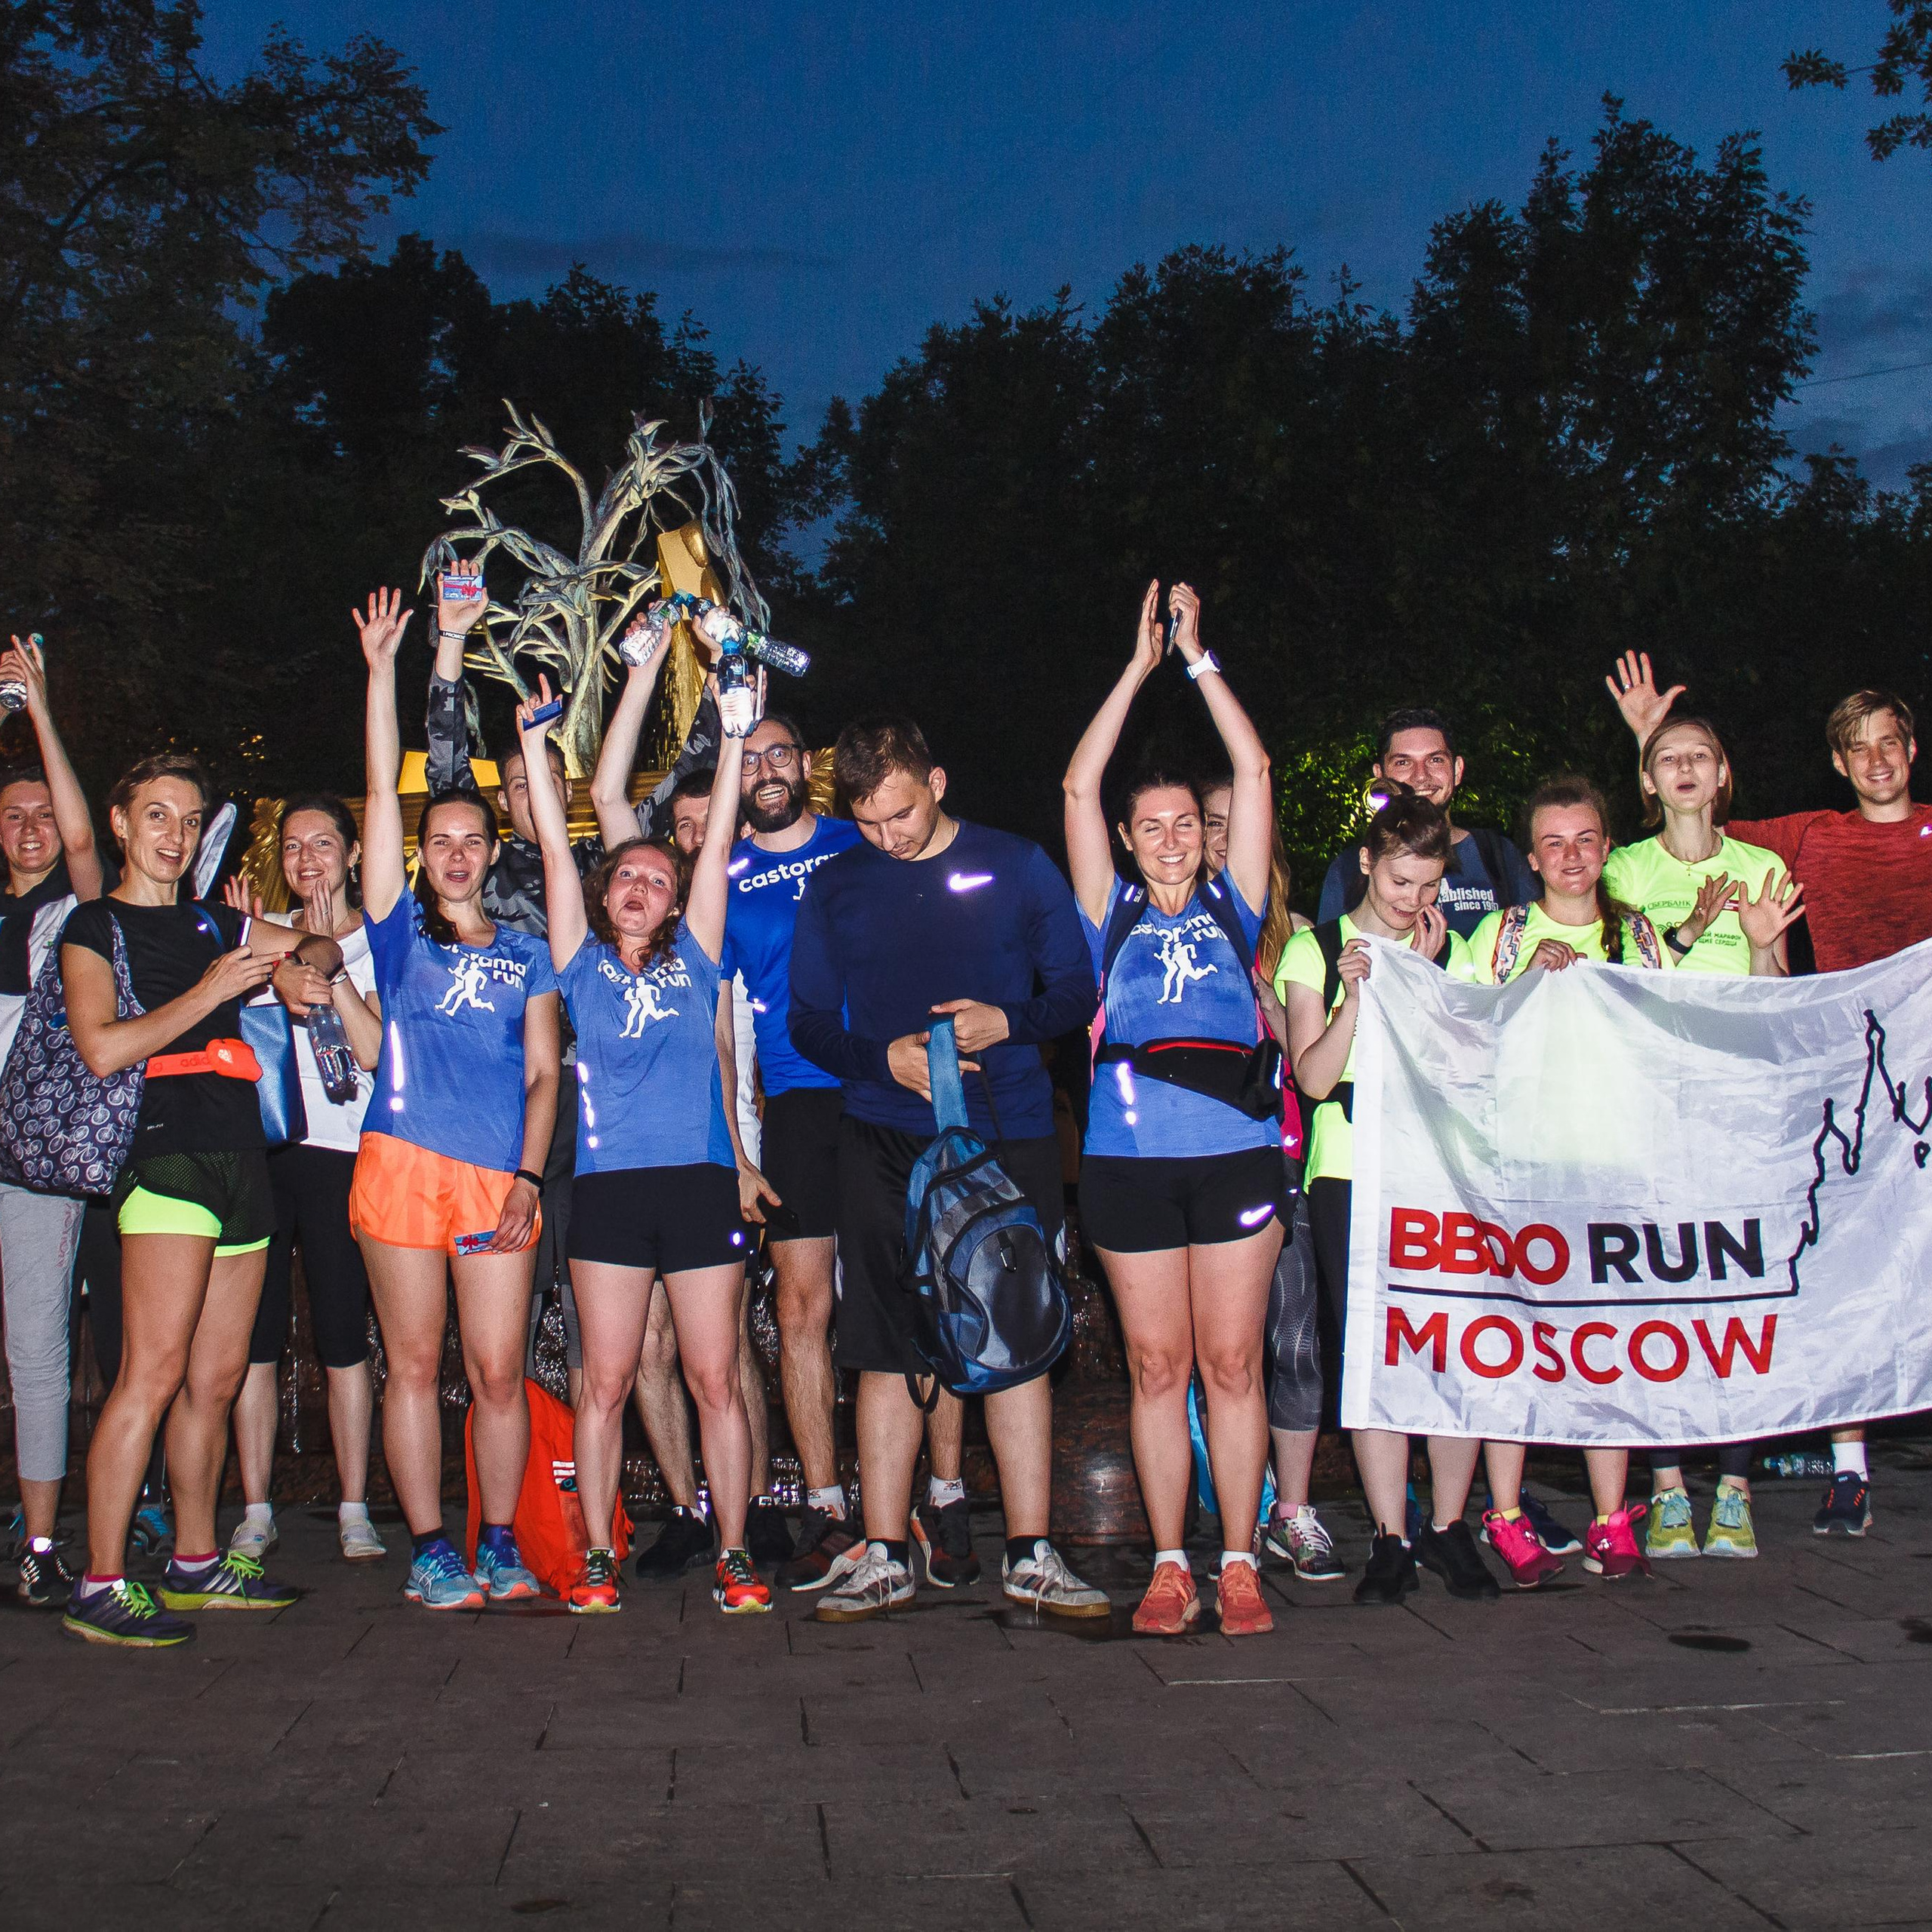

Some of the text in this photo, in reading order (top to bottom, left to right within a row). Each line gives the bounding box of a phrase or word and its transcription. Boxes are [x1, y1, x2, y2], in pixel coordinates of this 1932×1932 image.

[739, 853, 838, 893] castor
[1454, 900, 1481, 912] since
[1648, 900, 1692, 910] СБЕРБАНК
[1192, 925, 1229, 942] run
[493, 969, 524, 992] run
[657, 973, 692, 989] run
[1389, 1206, 1765, 1285] BBDO RUN
[1384, 1306, 1777, 1384] MOSCOW
